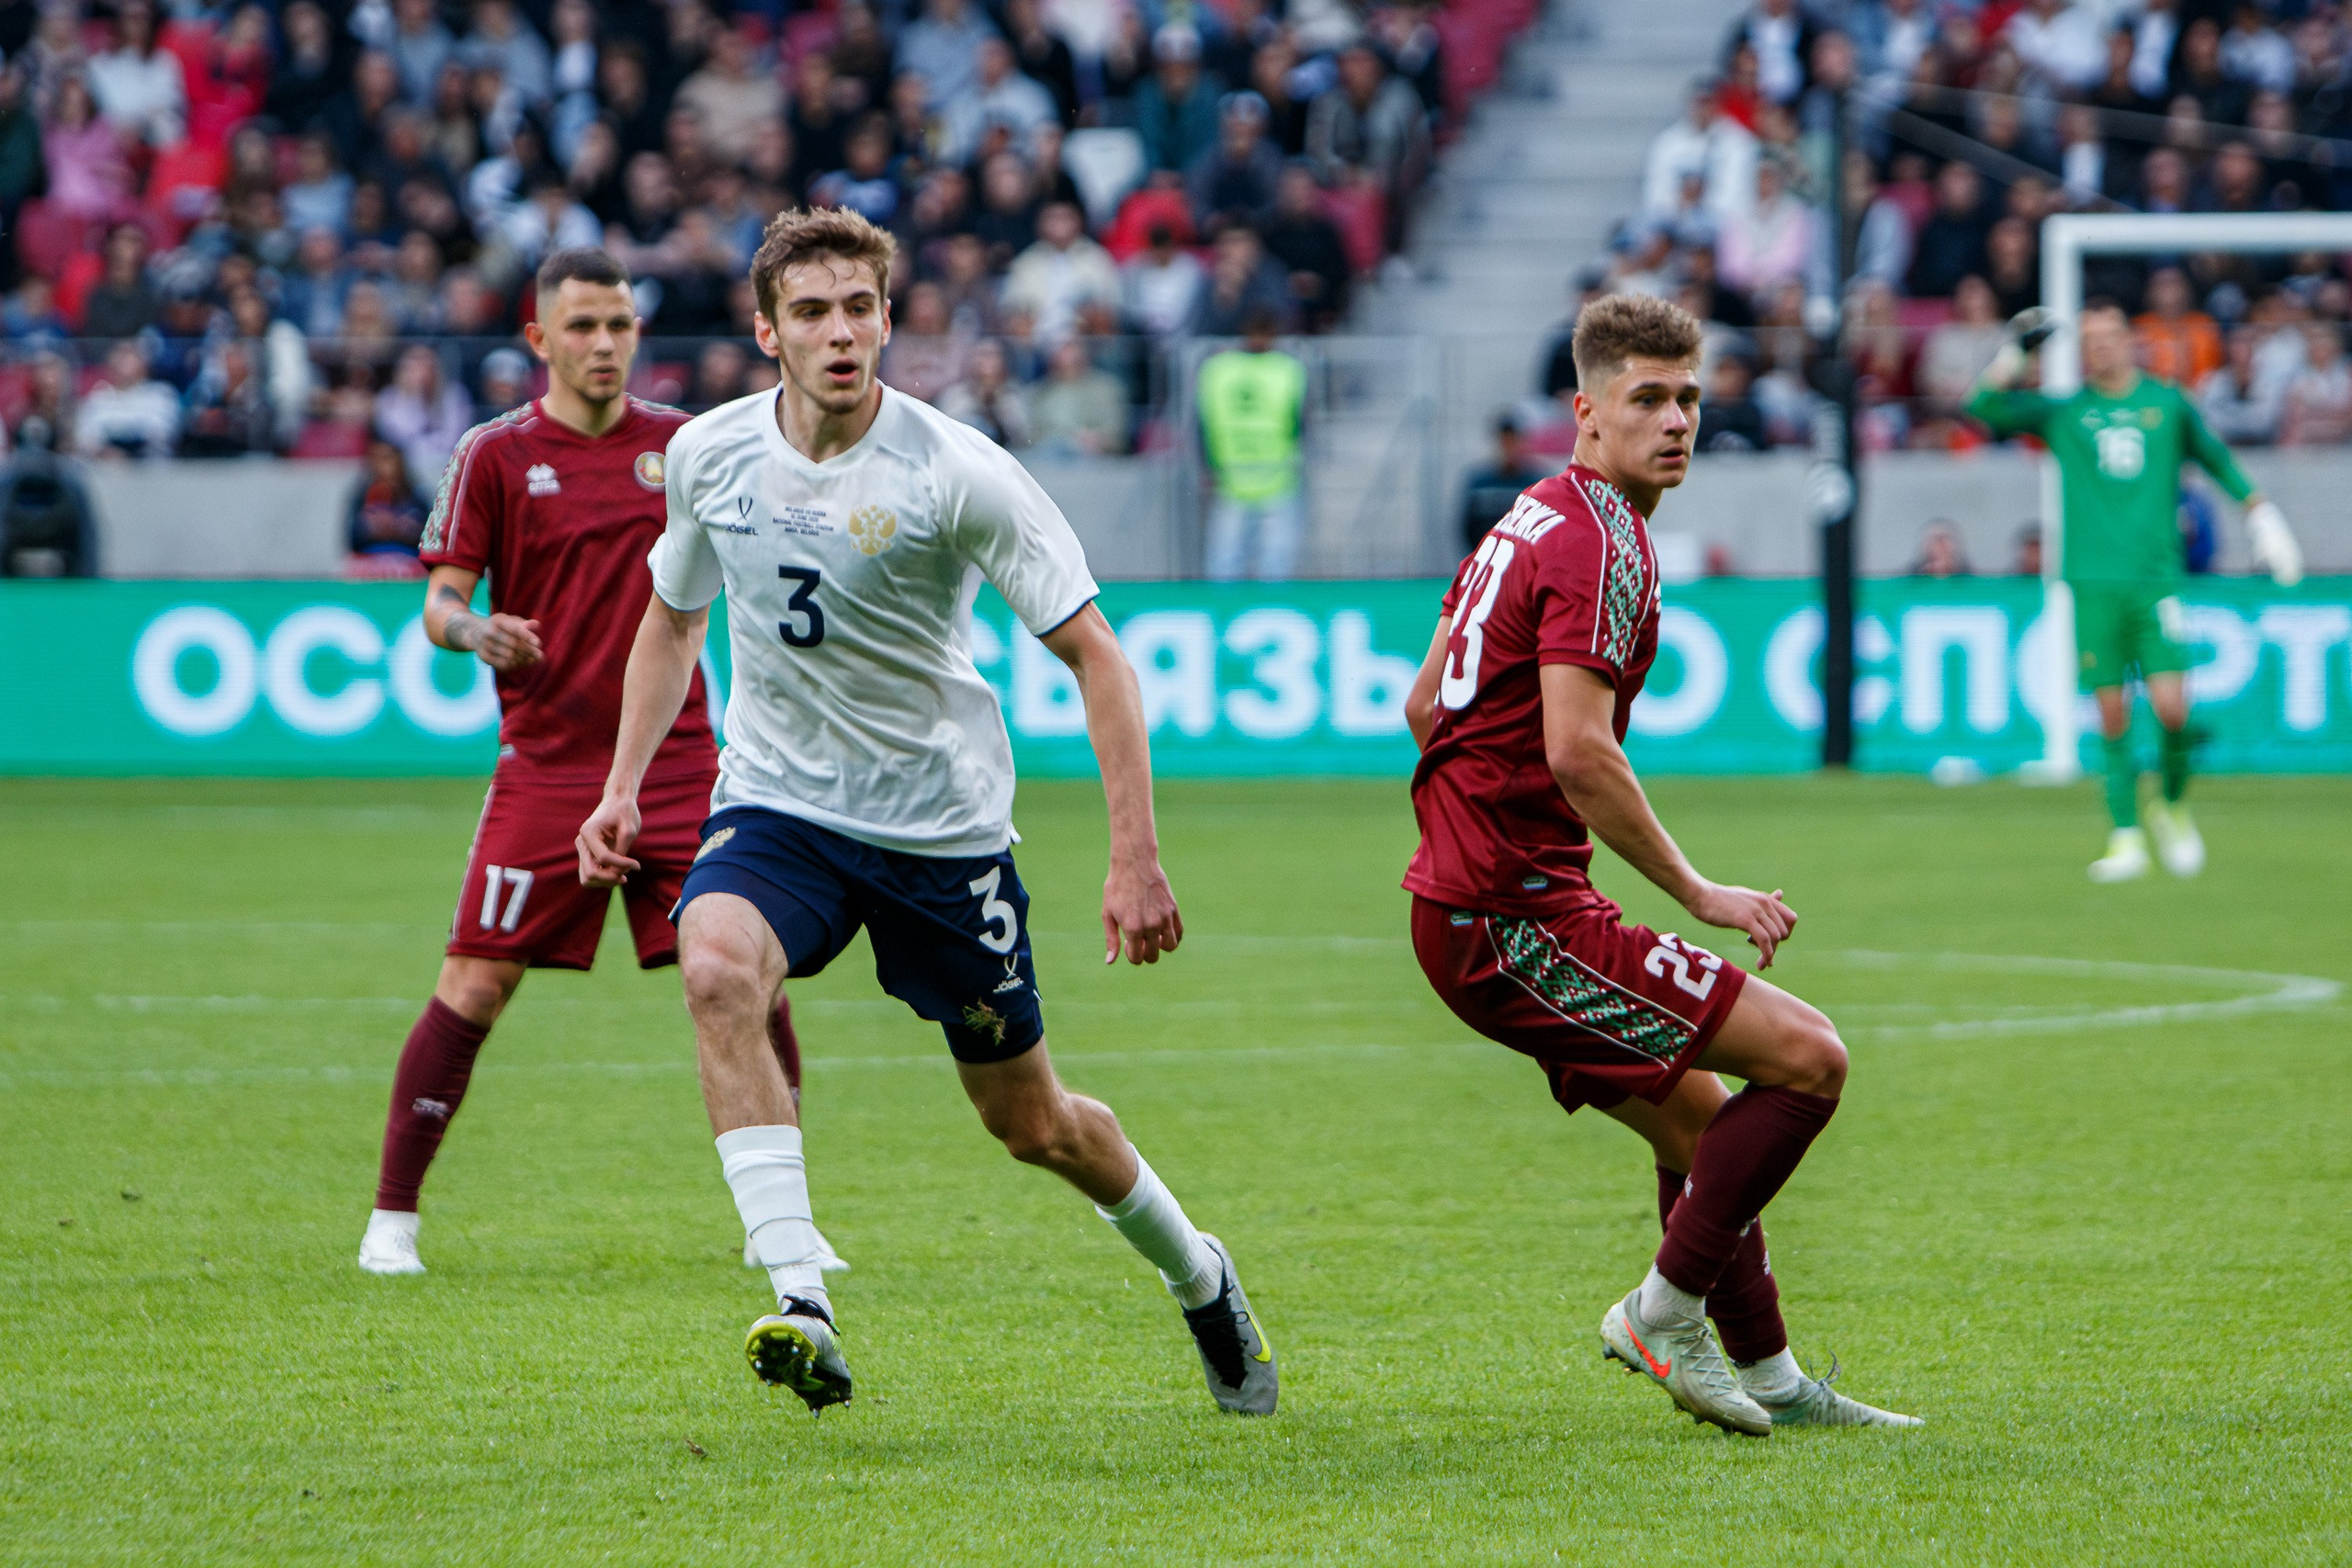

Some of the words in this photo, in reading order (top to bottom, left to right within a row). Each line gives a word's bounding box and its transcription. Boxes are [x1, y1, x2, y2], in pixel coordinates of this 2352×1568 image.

[2096, 426, 2145, 479] 16
[778, 564, 825, 648] 3
[480, 864, 535, 932] 17
[969, 865, 1018, 953] 3
[1644, 931, 1724, 1001] 23
